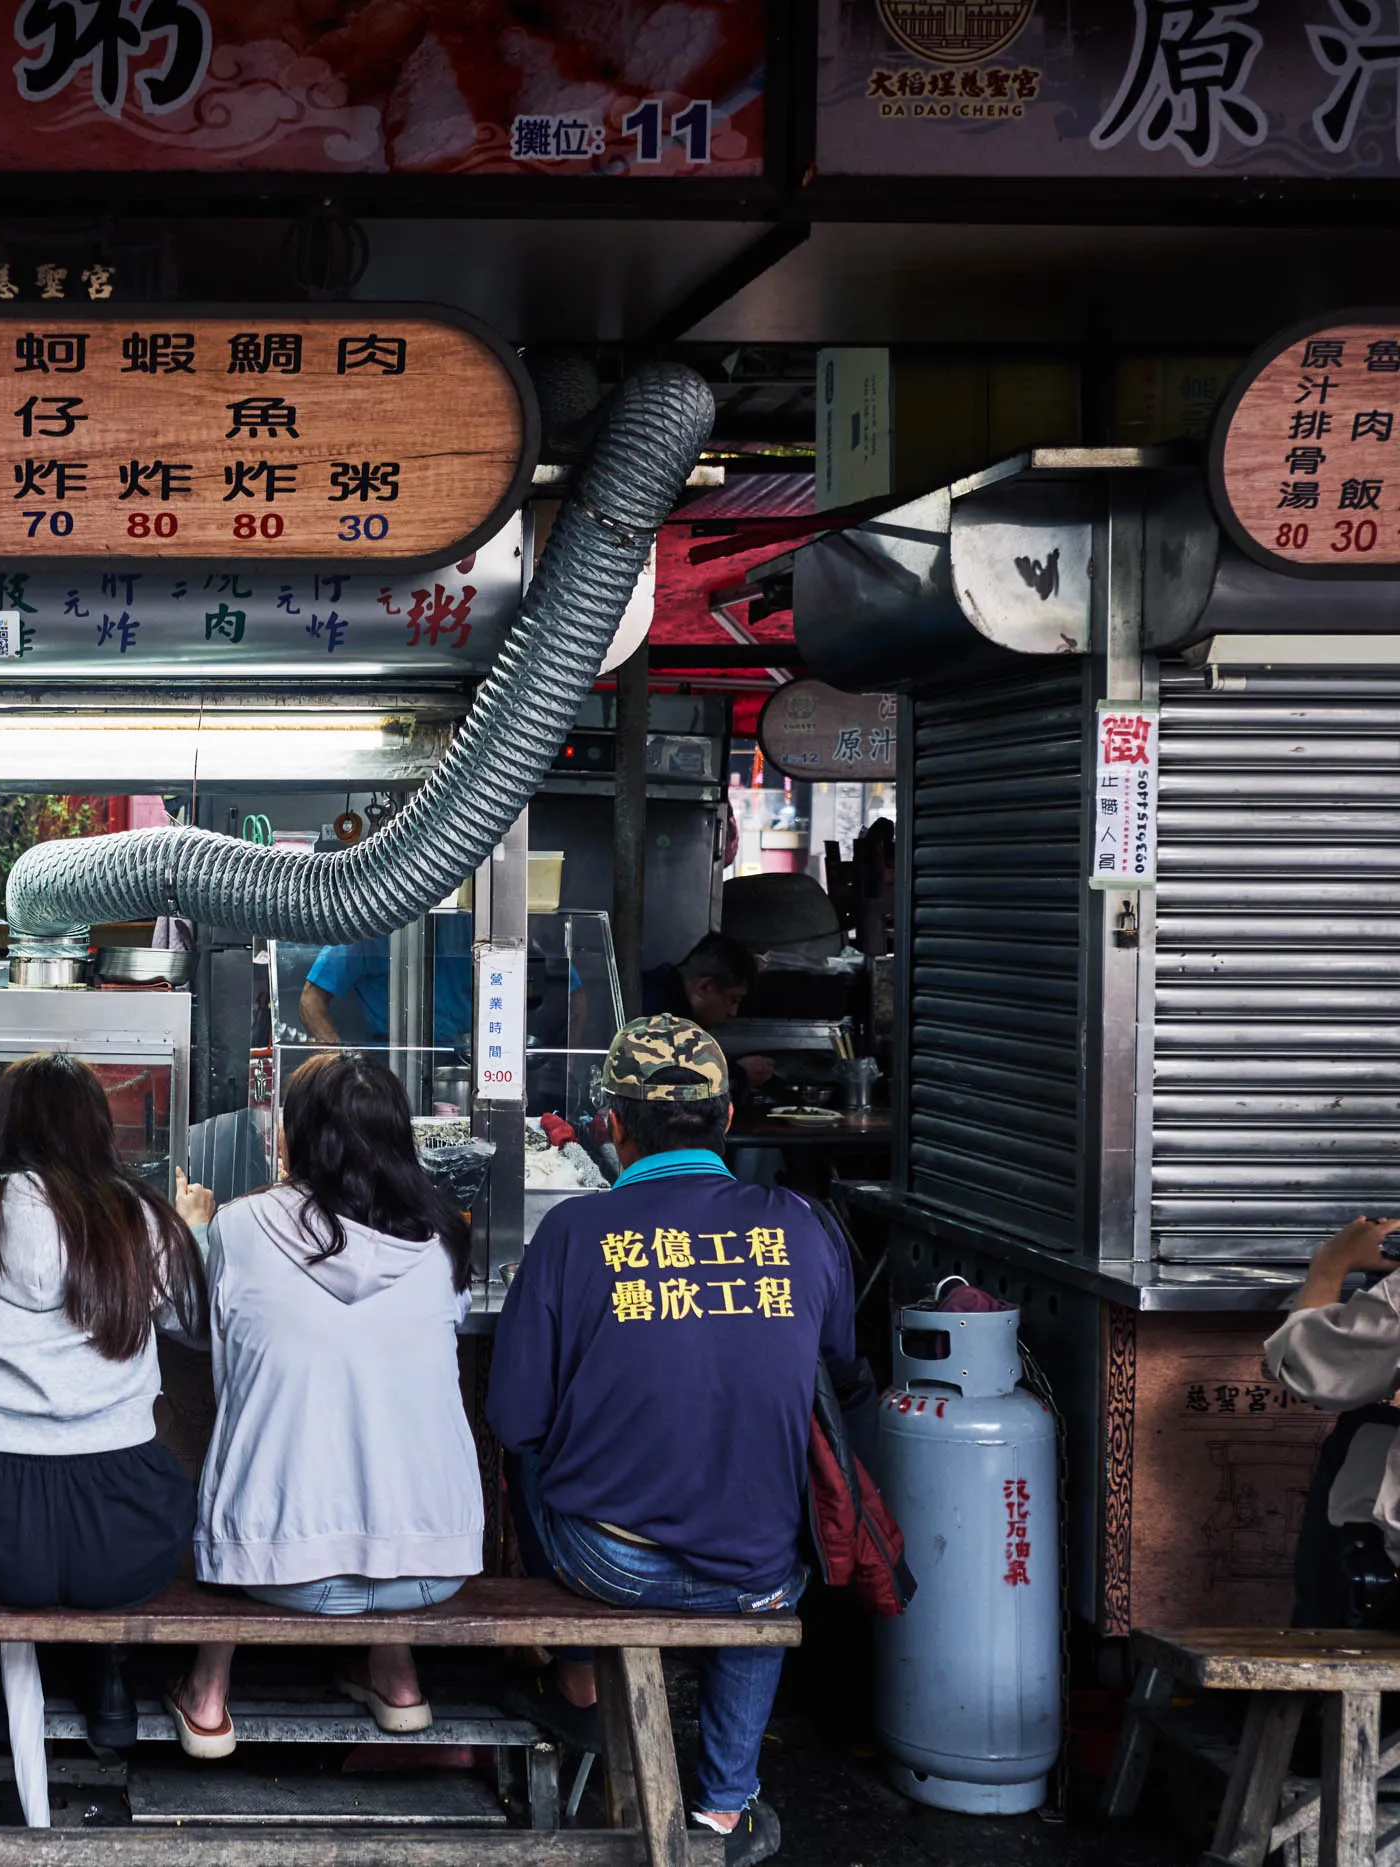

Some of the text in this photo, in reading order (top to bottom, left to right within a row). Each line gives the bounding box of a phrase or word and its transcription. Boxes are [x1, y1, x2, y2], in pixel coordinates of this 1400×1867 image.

[882, 104, 1023, 116] DA DAO CHENG
[623, 101, 710, 161] 11
[13, 332, 91, 501] 蚵仔炸
[222, 332, 303, 502] 鯛魚炸
[1276, 340, 1347, 510] 原汁排骨湯
[22, 511, 74, 538] 70
[126, 512, 179, 539] 80
[232, 513, 285, 540] 80
[337, 514, 390, 542] 30
[1275, 522, 1309, 550] 80
[1330, 519, 1378, 553] 30
[488, 972, 503, 1059] 營業時間
[484, 1070, 513, 1083] 9:00
[600, 1226, 791, 1273] 乾億工程
[1185, 1385, 1323, 1412] 慈聖宮小
[1002, 1477, 1031, 1588] 液化石油氣
